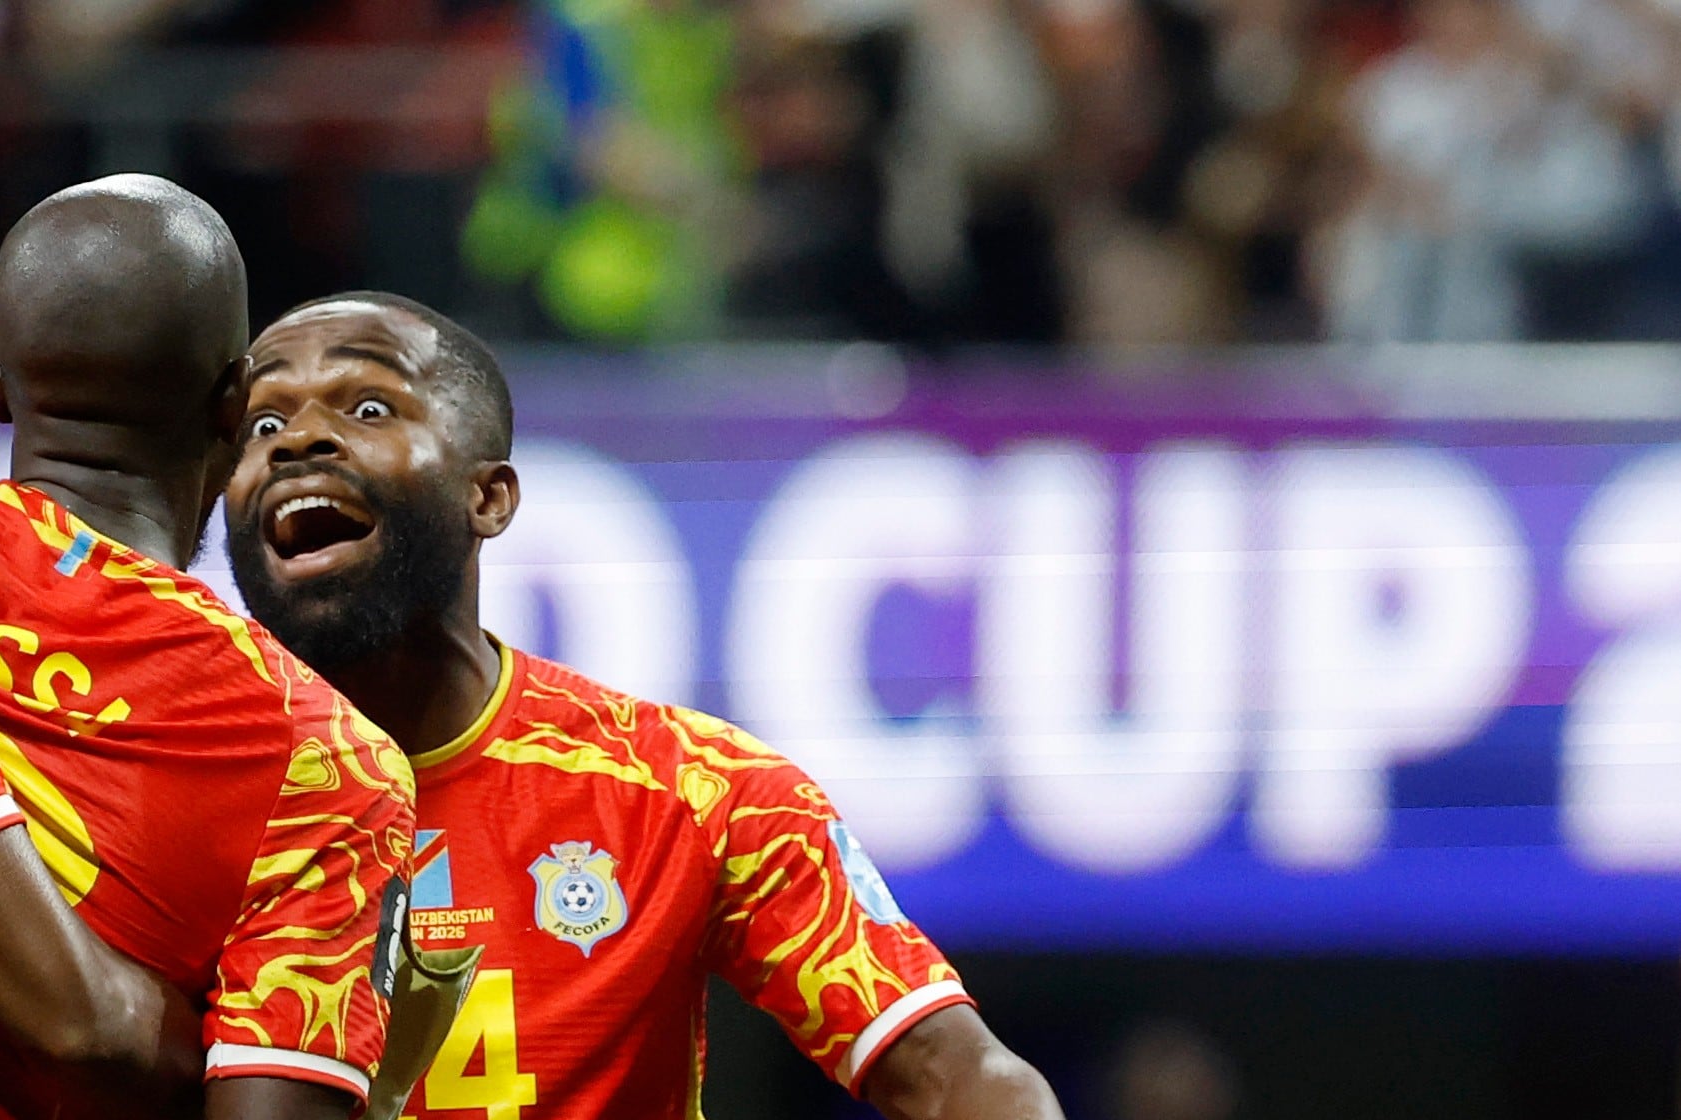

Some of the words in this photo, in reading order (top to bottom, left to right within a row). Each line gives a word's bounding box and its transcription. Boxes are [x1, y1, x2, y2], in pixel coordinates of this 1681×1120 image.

[730, 434, 1533, 868] CUP
[409, 908, 494, 927] UZBEKISTAN
[554, 916, 610, 936] FECOFA
[427, 926, 466, 941] 2026
